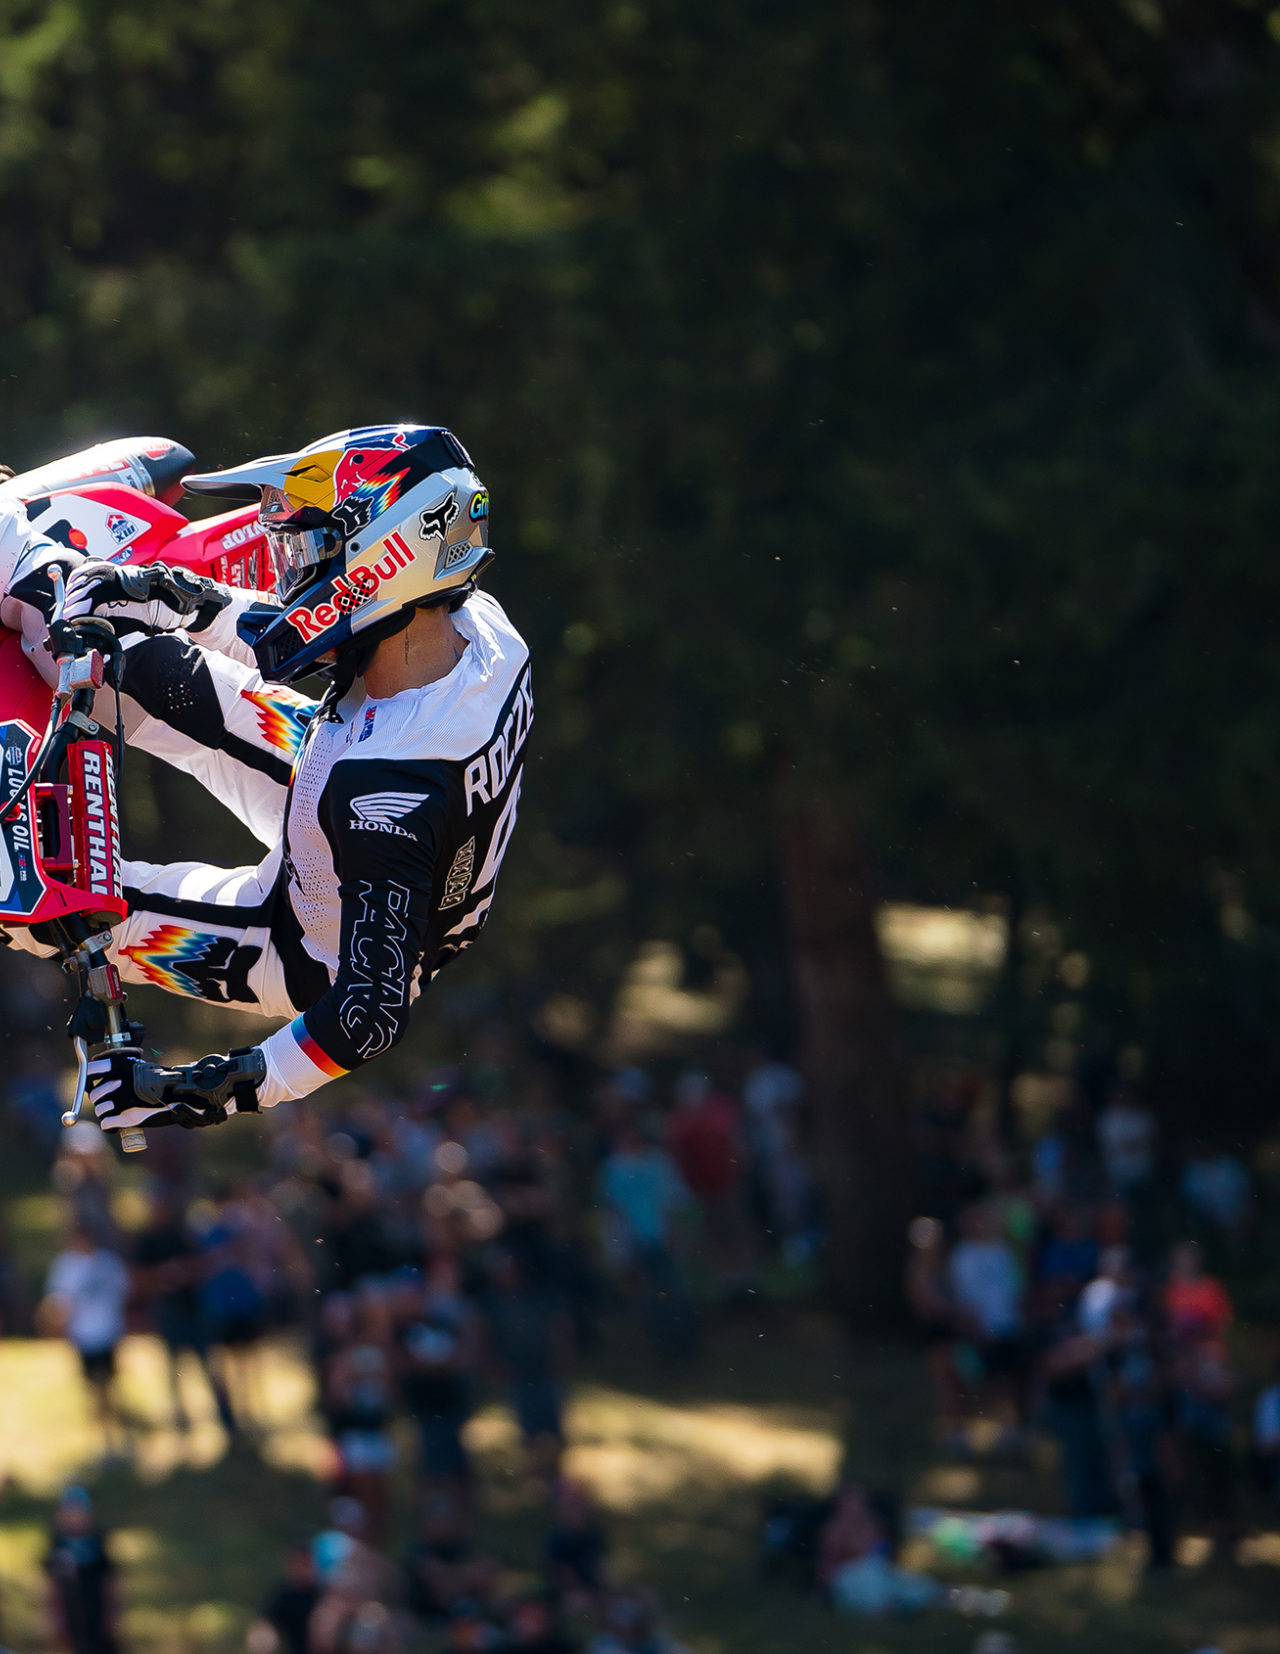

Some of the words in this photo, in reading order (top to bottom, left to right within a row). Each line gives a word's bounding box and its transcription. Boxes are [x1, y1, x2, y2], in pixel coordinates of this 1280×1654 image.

[287, 577, 358, 643] Red
[347, 532, 416, 598] Bull
[12, 824, 30, 853] OIL
[350, 819, 419, 842] HONDA
